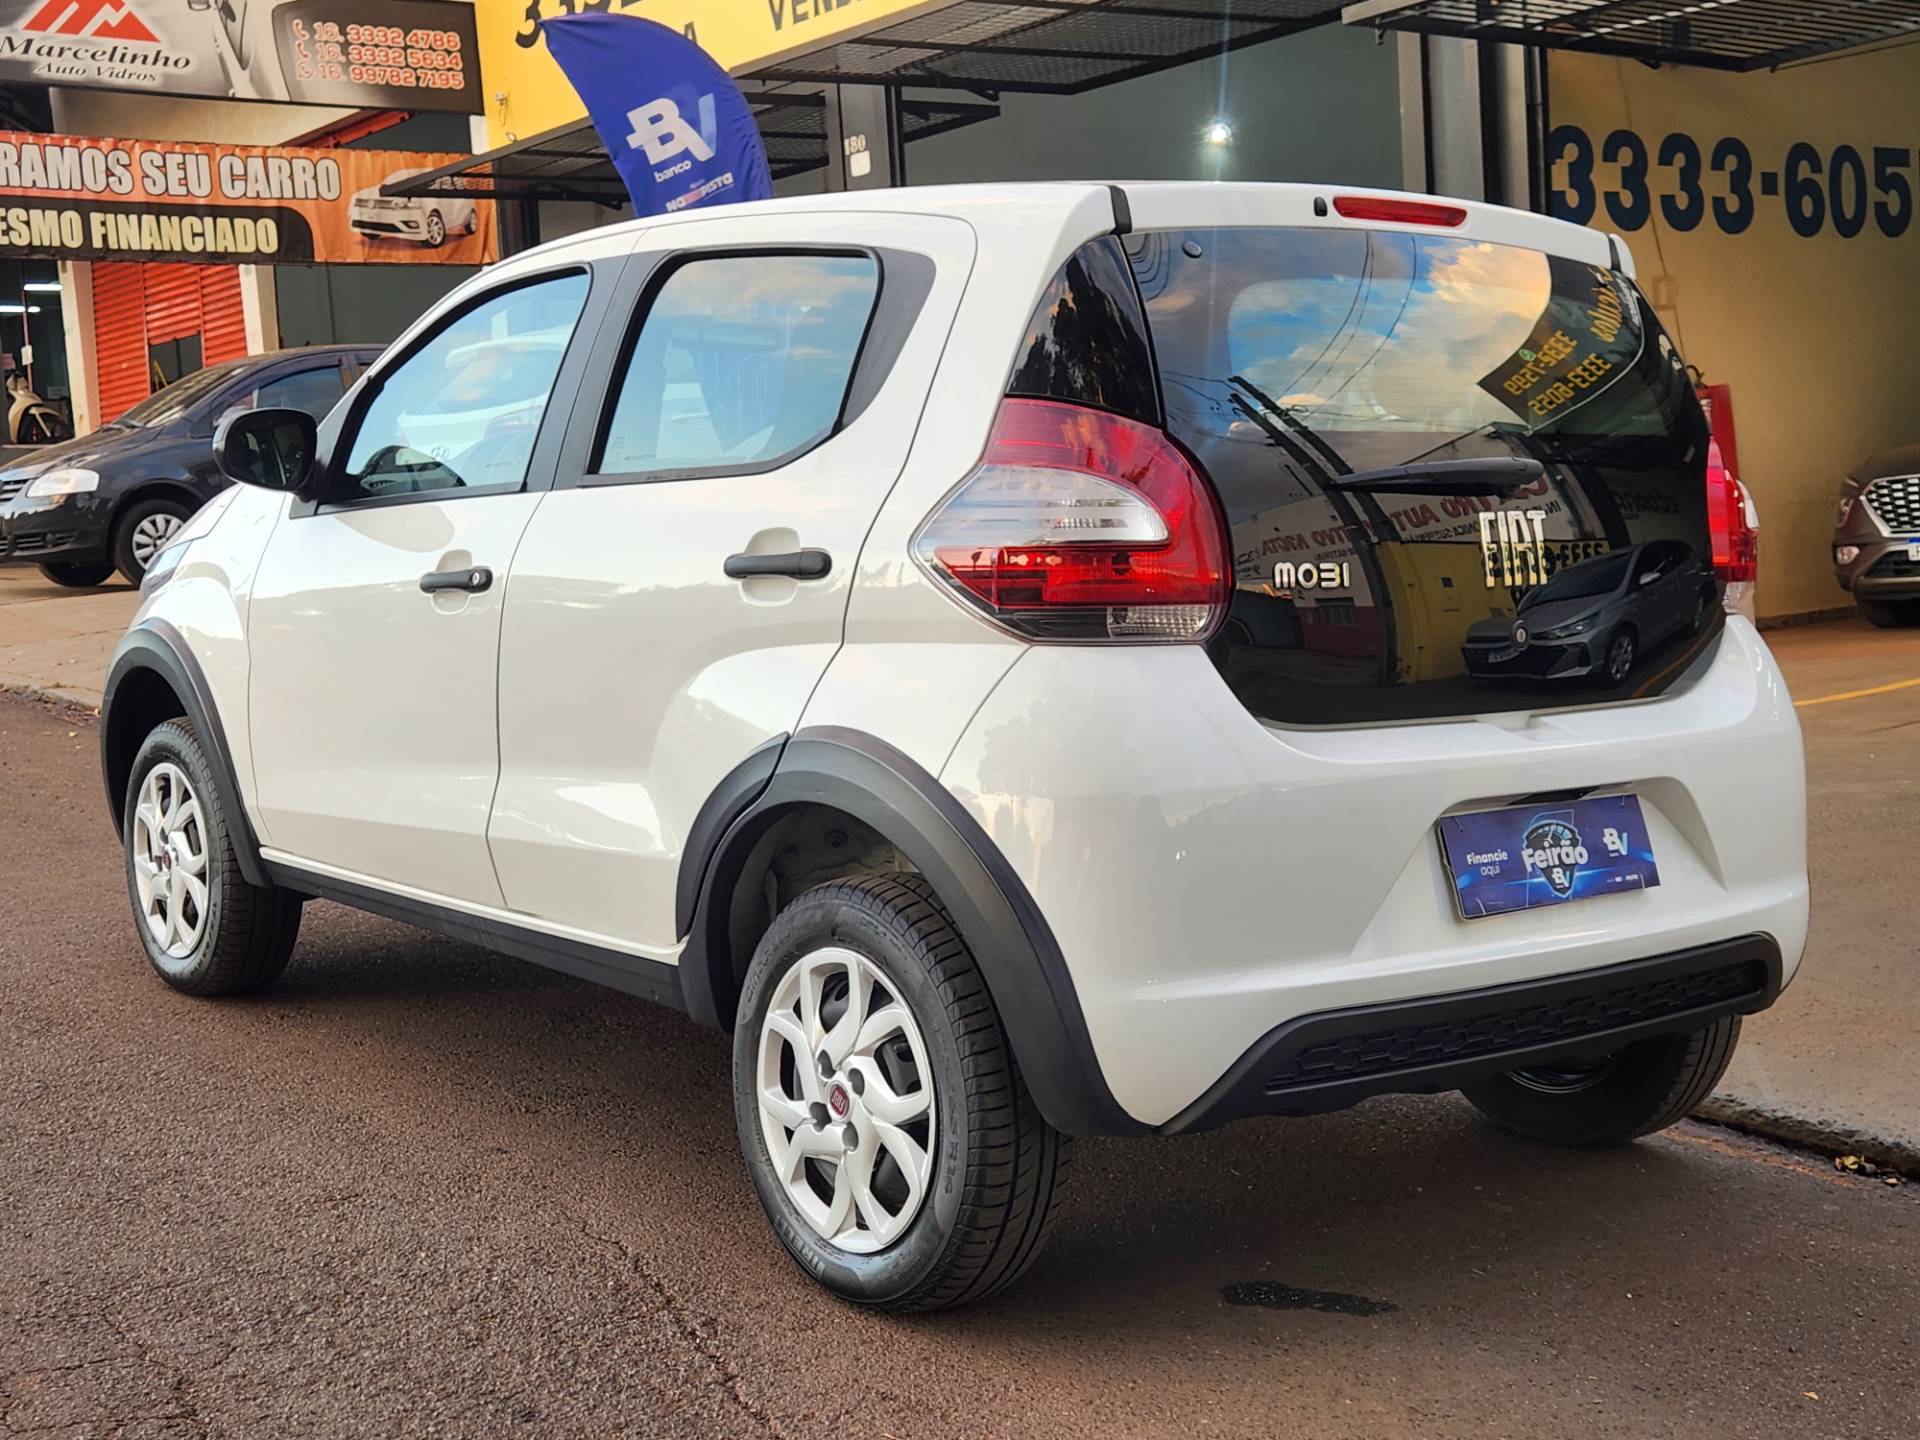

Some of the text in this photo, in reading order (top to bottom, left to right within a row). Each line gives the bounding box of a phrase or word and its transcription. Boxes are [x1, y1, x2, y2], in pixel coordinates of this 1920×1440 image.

[346, 24, 404, 47] 3332
[406, 29, 461, 51] 4786
[1, 36, 191, 69] Marcelinho
[349, 45, 405, 67] 3332
[407, 49, 463, 70] 5634
[38, 63, 157, 82] Auto Vidros
[350, 65, 416, 86] 99782
[416, 69, 465, 90] 7195
[0, 142, 342, 201] RAMOS SEU CARRO
[654, 160, 692, 183] banco
[1547, 125, 1920, 238] 3333-605
[0, 207, 279, 254] ESMO FINANCIADO
[1478, 510, 1548, 588] FIAT
[1273, 561, 1350, 589] MOBI
[1521, 838, 1589, 872] Feirão
[1602, 827, 1628, 855] BV
[1466, 848, 1508, 865] Financie
[1480, 861, 1501, 877] aqui
